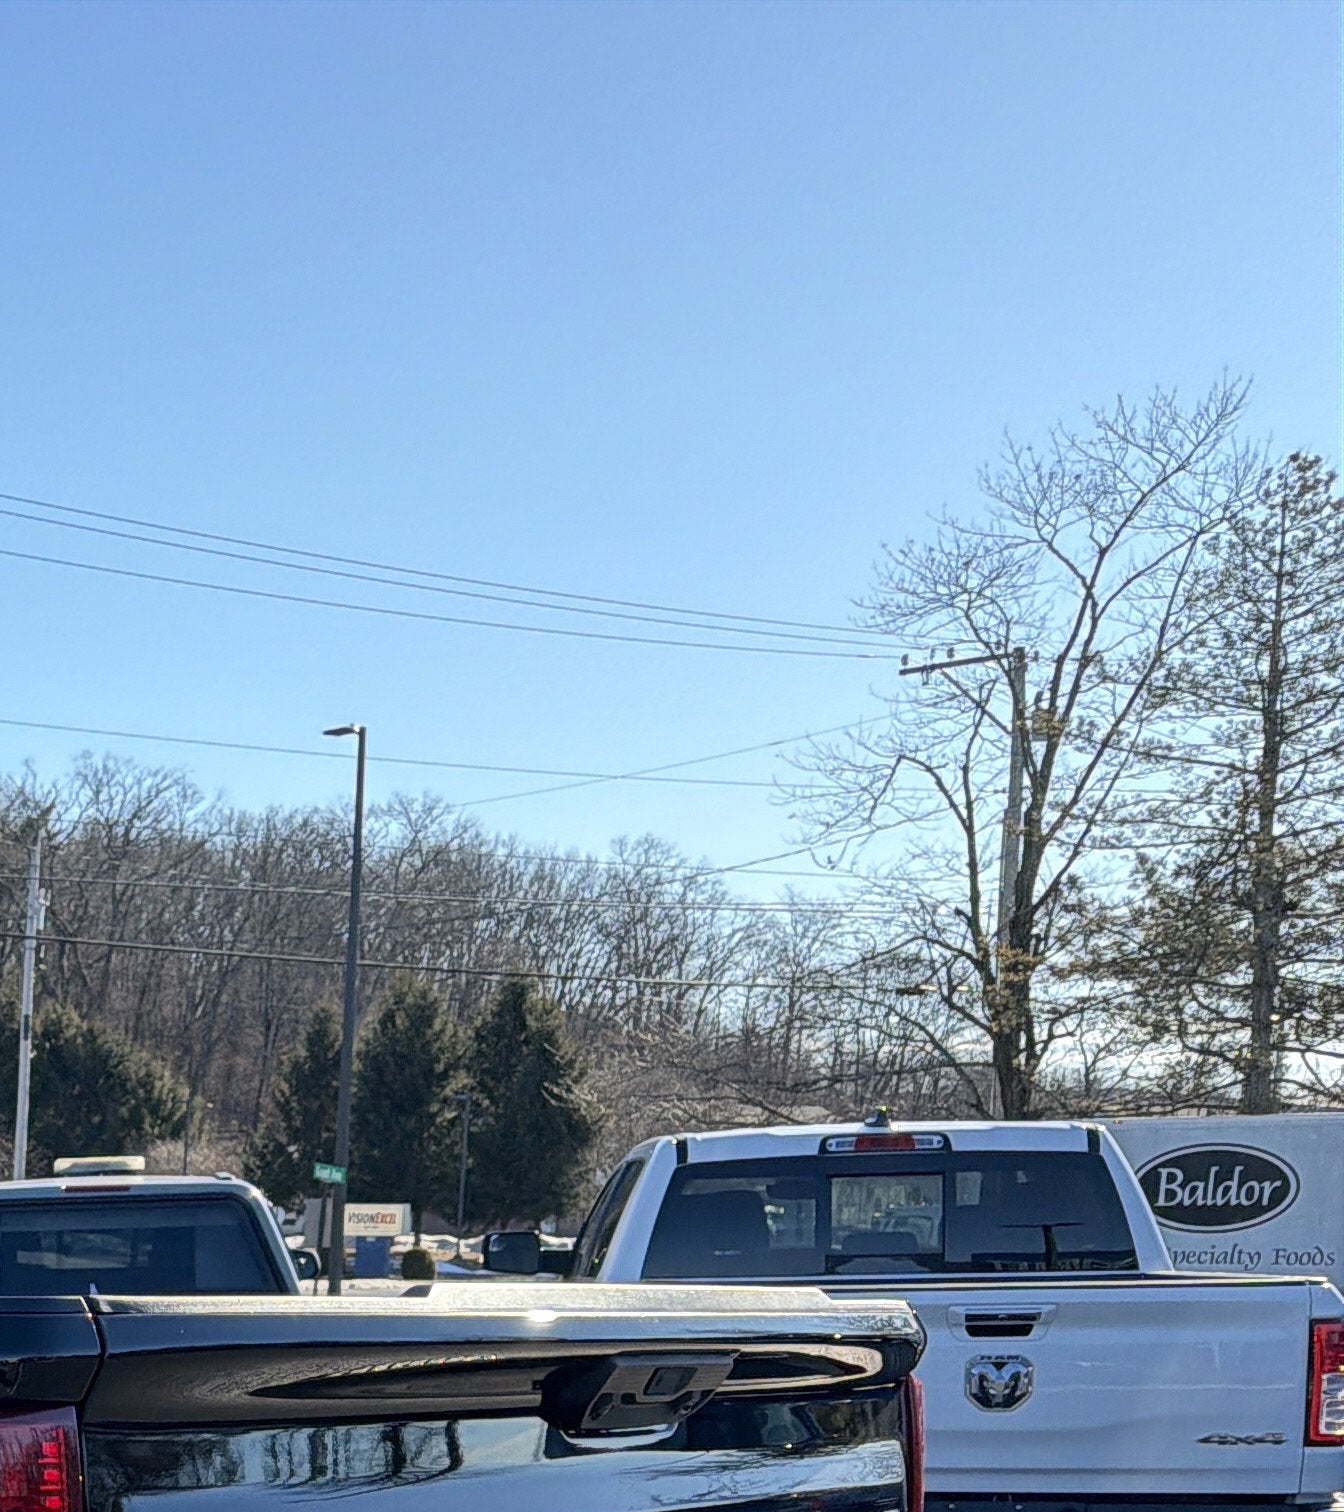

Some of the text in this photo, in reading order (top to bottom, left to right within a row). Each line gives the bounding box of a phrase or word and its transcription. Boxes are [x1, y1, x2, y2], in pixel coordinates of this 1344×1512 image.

[1154, 1166, 1282, 1207] Baldor
[1168, 1243, 1336, 1271] pecialty Foods
